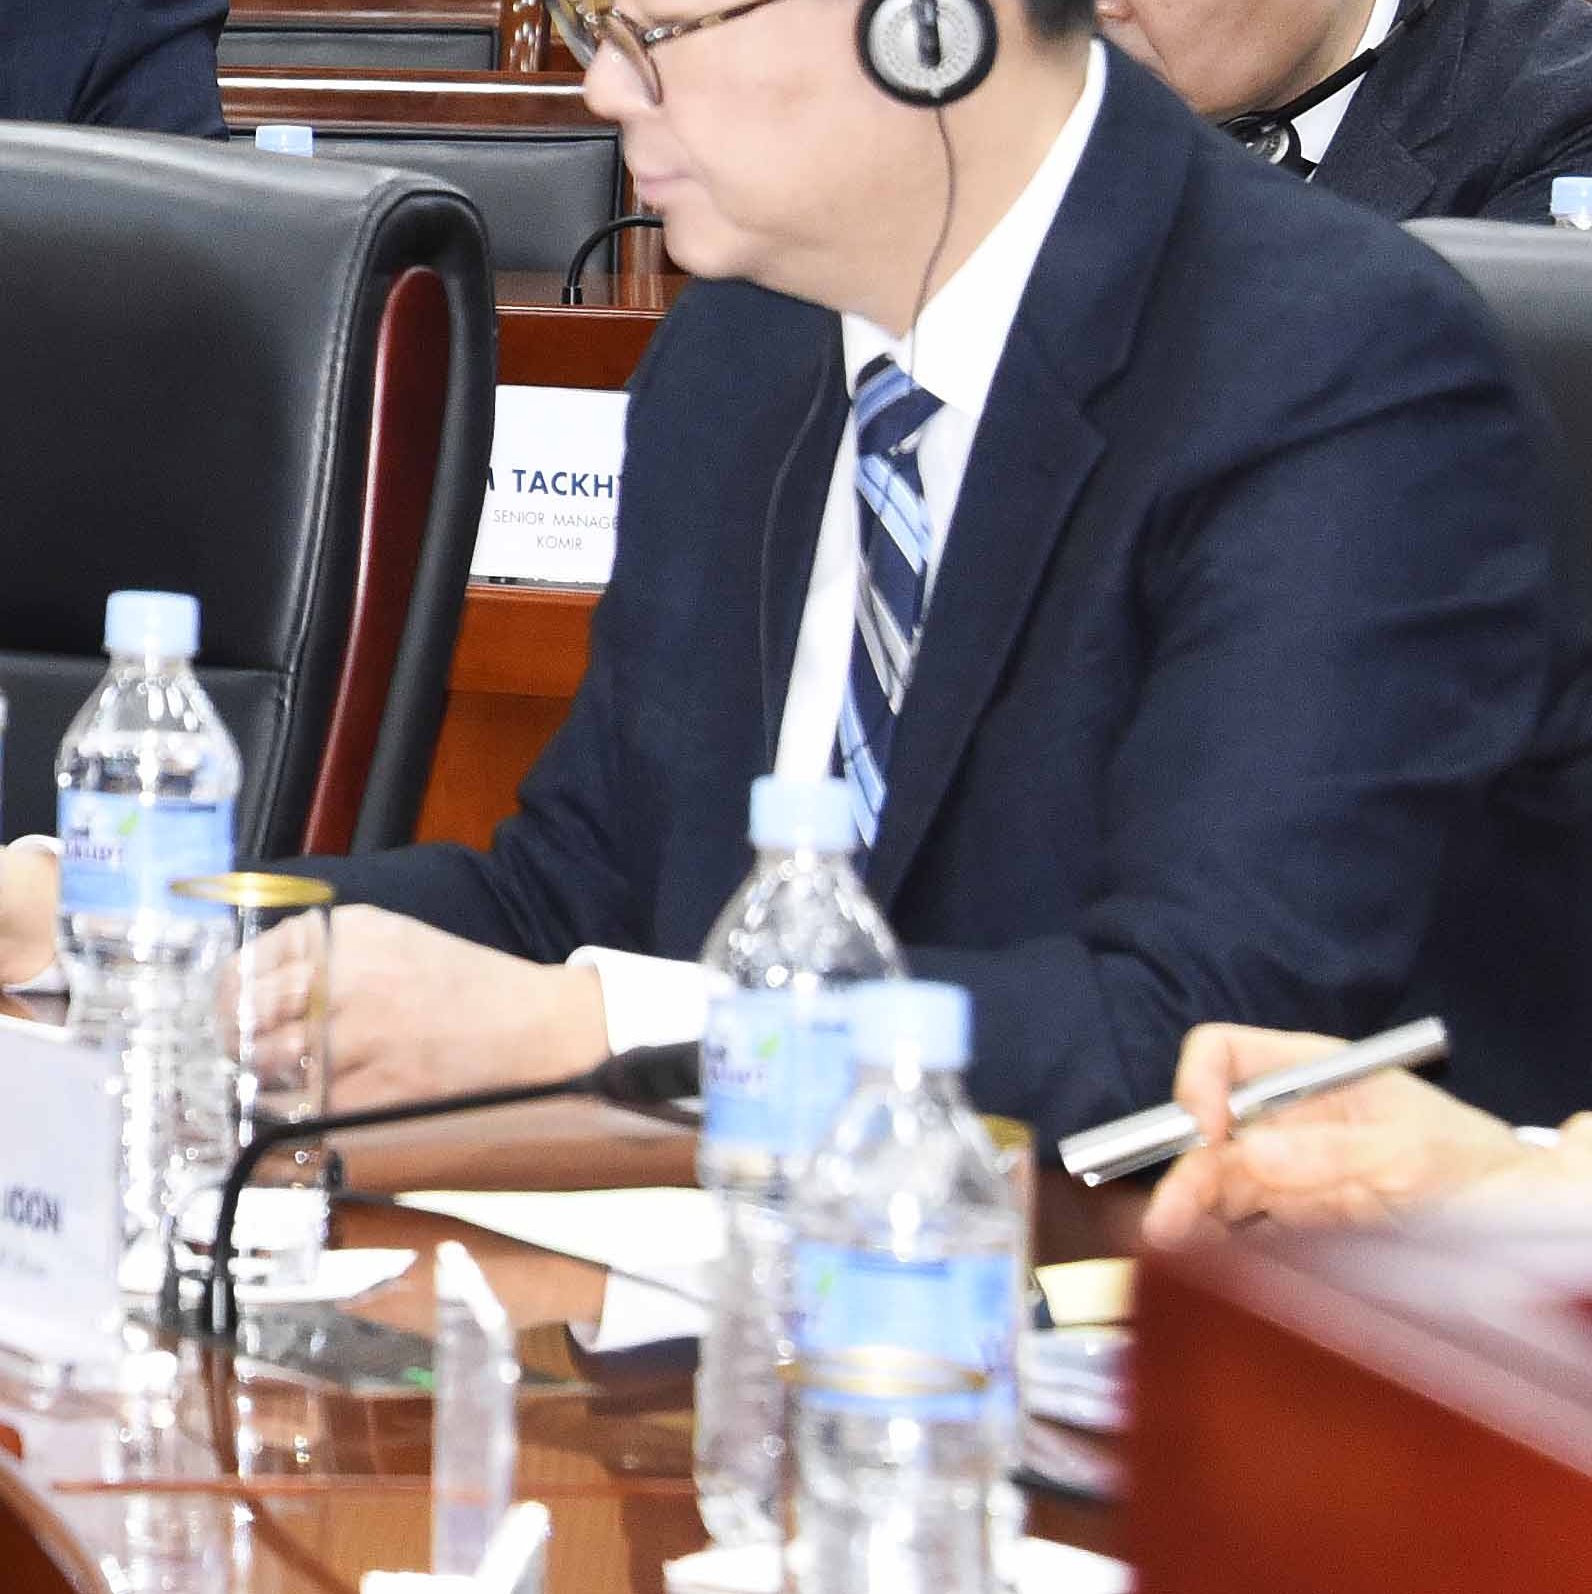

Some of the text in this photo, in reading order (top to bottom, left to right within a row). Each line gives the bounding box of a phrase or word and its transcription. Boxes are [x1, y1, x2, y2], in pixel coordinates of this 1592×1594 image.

[512, 468, 620, 499] TACKH
[493, 509, 619, 530] SENIOR MANAGE
[536, 535, 583, 551] KOMIR
